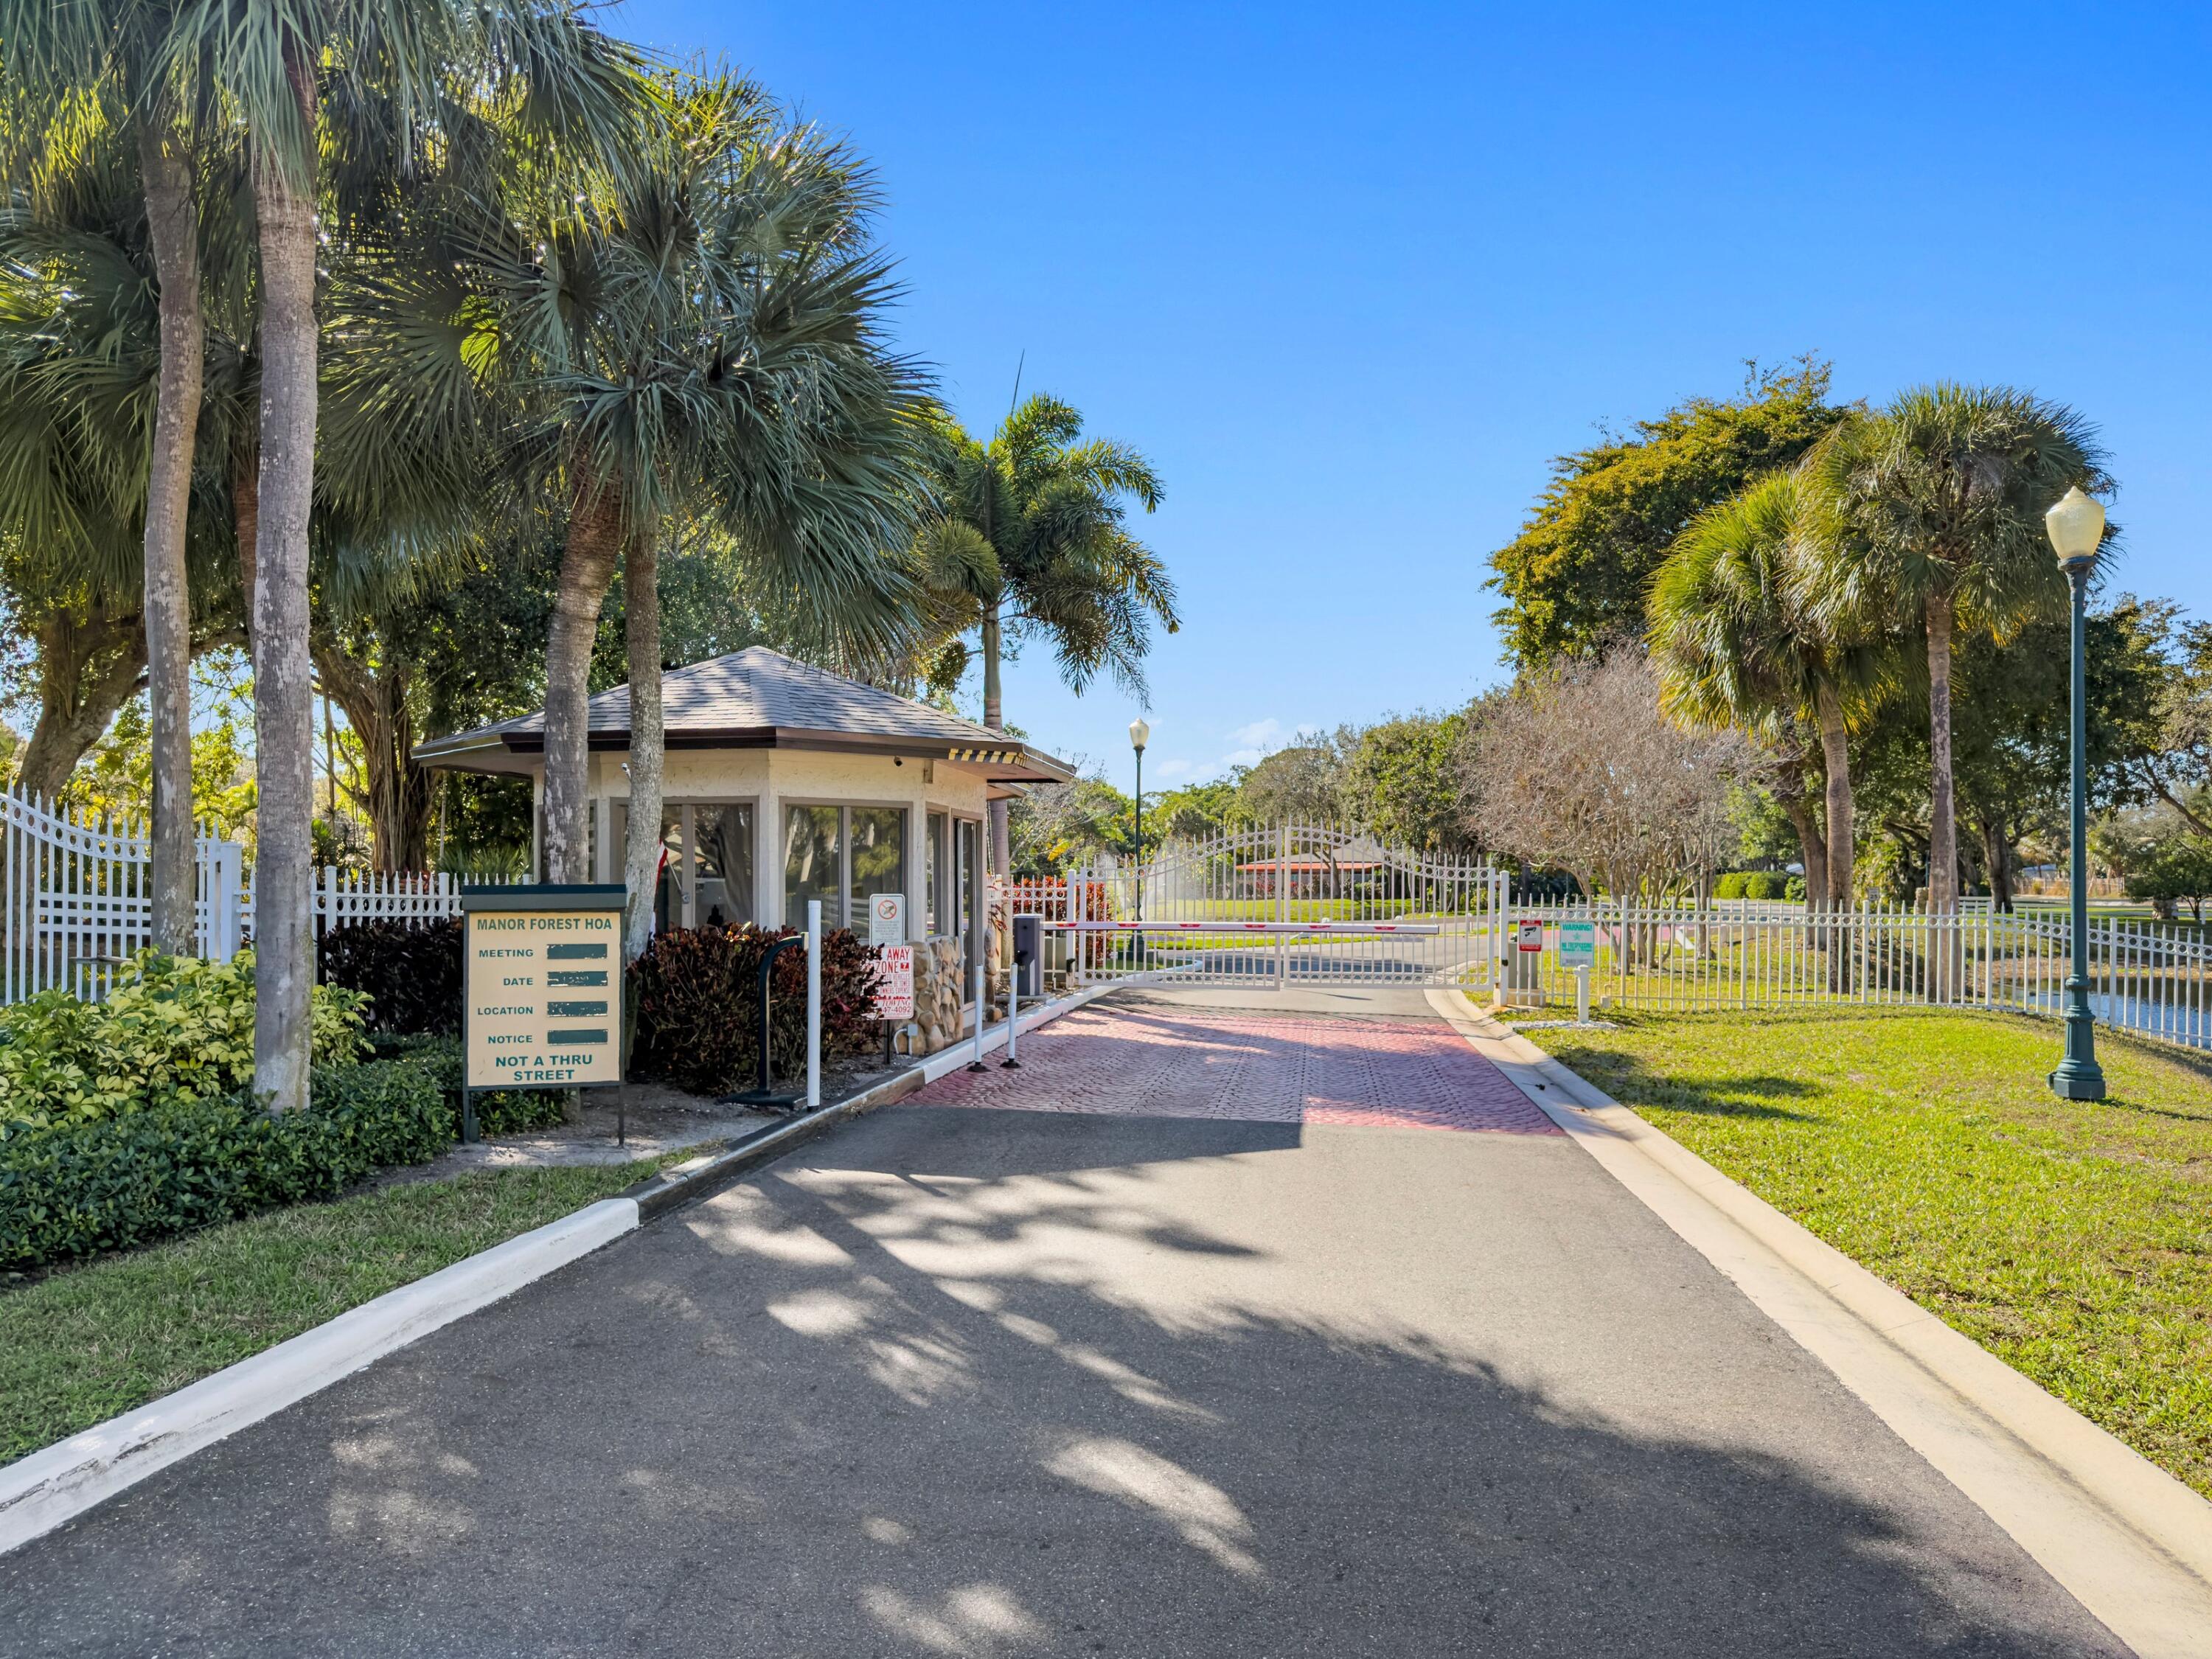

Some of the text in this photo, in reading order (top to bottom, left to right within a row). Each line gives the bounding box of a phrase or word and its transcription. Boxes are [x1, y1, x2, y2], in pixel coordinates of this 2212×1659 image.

[477, 918, 612, 930] MANOR FOREST HOA
[1562, 923, 1593, 931] WARNING!
[479, 949, 534, 958] MEETING
[887, 947, 911, 960] AWAY
[875, 961, 899, 973] ZONE
[503, 978, 534, 986] DATE
[477, 1006, 534, 1015] LOCATION
[487, 1035, 533, 1044] NOTICE
[495, 1054, 593, 1067] NOT A THRU
[513, 1069, 575, 1082] STREET
